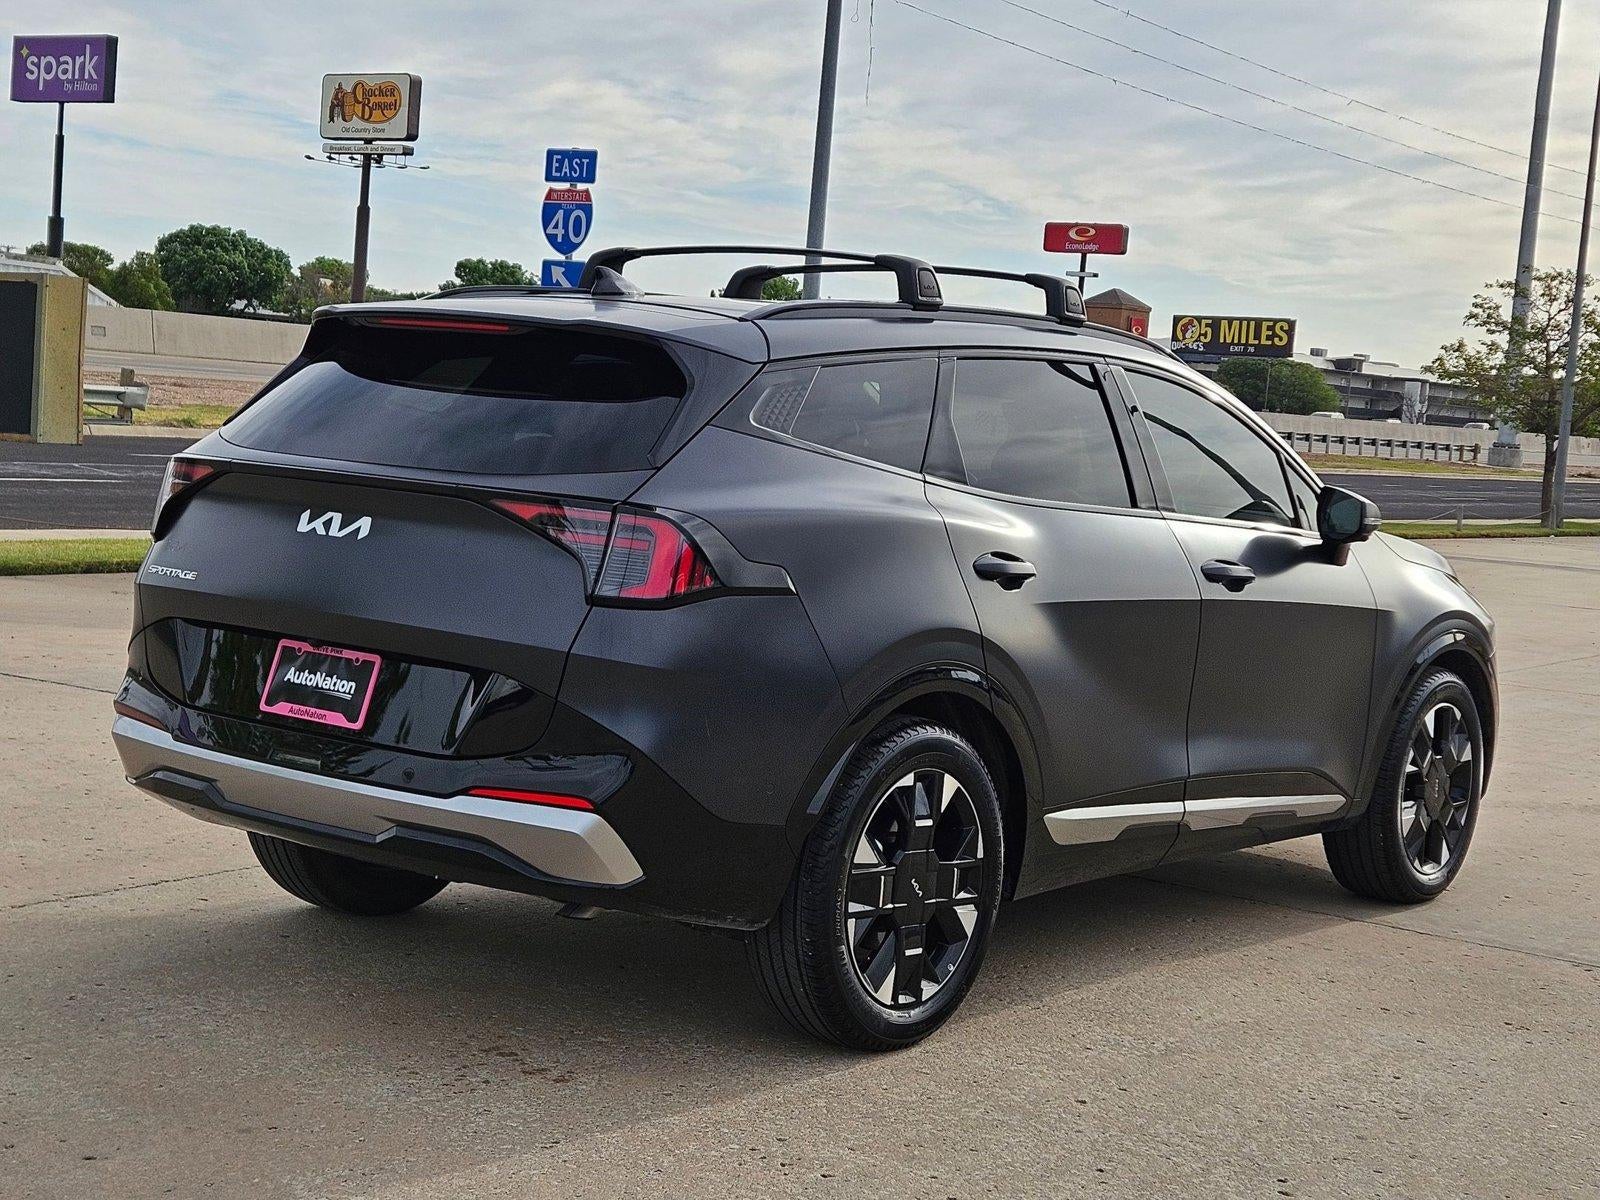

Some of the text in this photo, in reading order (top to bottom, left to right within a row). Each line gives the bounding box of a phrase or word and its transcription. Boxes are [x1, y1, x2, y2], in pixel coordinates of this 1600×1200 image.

[25, 44, 99, 91] spark
[63, 80, 98, 93] by Hilton
[353, 82, 396, 104] Cracker
[361, 98, 398, 121] Barrel
[351, 126, 371, 135] Country
[371, 126, 386, 134] Store
[552, 155, 590, 178] EAST
[551, 191, 587, 201] INTERSTATE
[546, 209, 587, 244] 40
[1065, 242, 1100, 252] EconoLodge
[1200, 319, 1289, 346] 5 MILES
[296, 508, 372, 540] KIA
[148, 564, 198, 581] SPORTAGE
[284, 667, 357, 696] AutoNation
[287, 705, 328, 721] AutoNation
